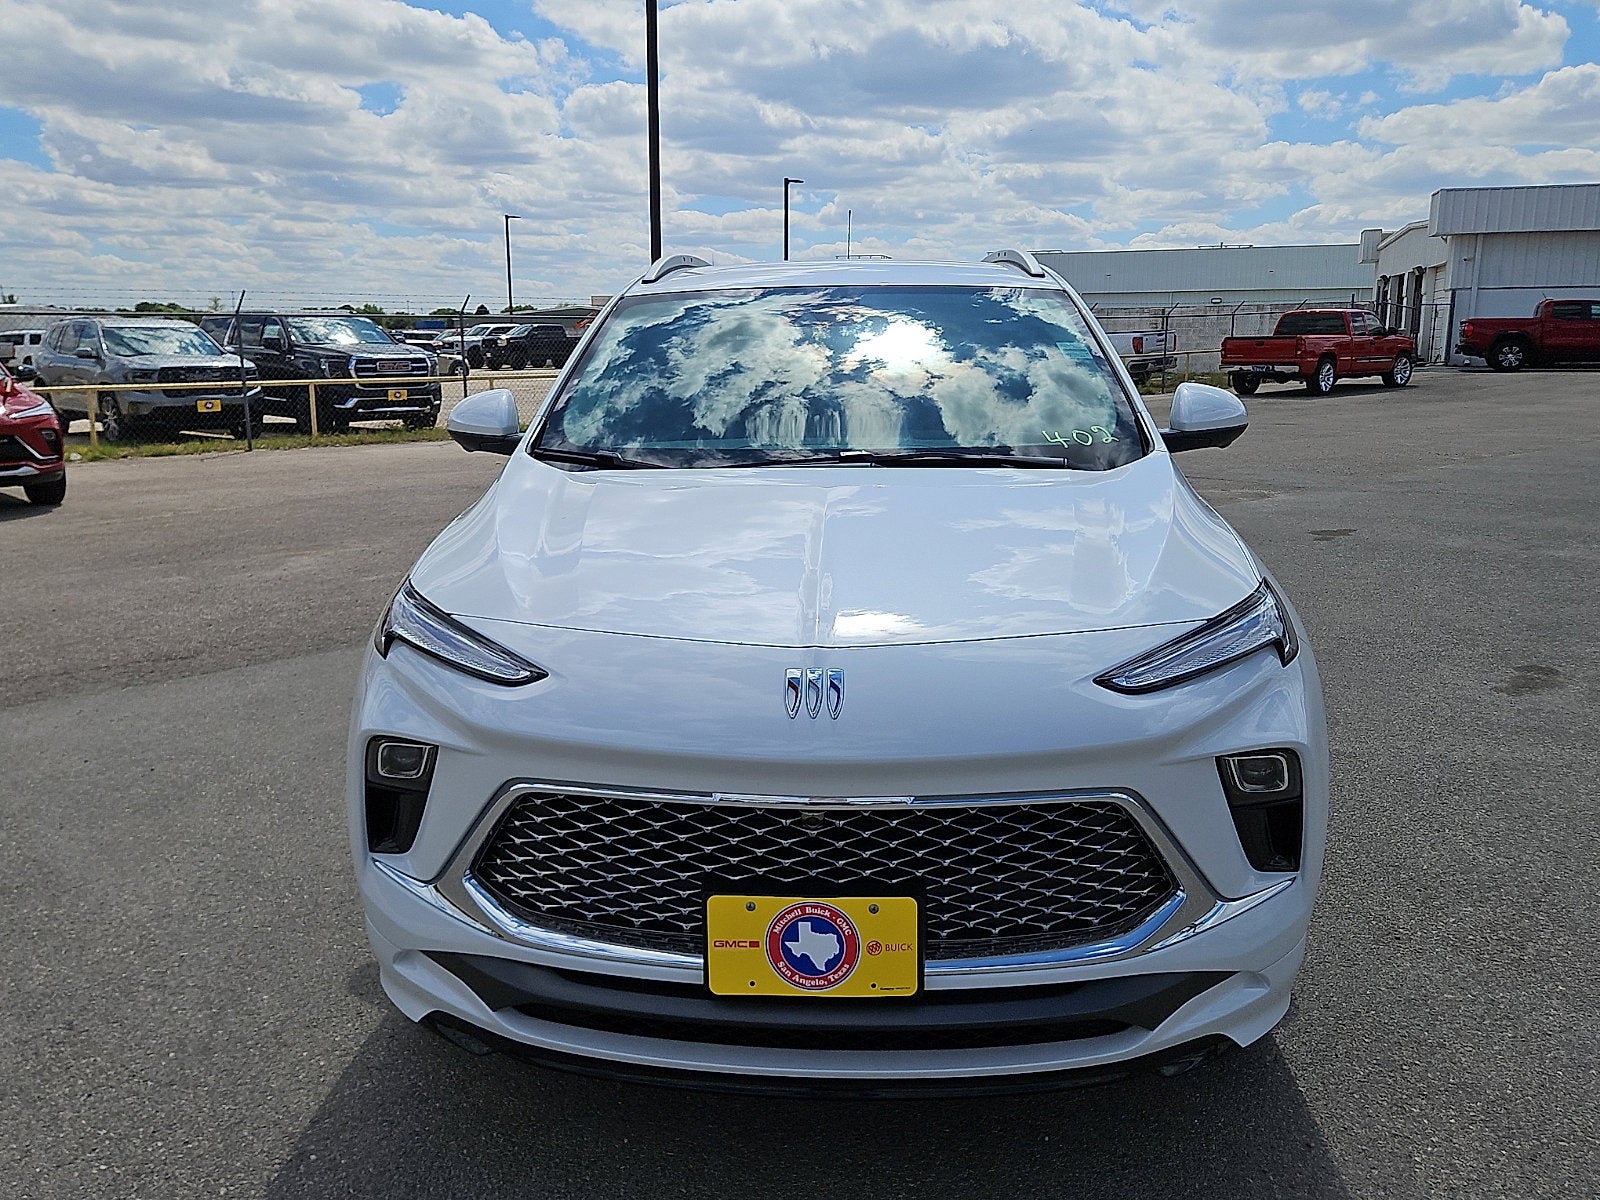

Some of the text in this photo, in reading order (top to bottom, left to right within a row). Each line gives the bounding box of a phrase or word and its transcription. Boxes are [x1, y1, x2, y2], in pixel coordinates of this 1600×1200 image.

[379, 362, 410, 370] GMC
[1042, 425, 1119, 448] 402
[773, 909, 802, 934] Mitchell
[805, 907, 831, 917] Buick
[836, 918, 852, 936] GMC
[713, 940, 748, 948] GMC
[885, 943, 913, 952] BUICK
[777, 961, 850, 986] San Angelo, Texas
